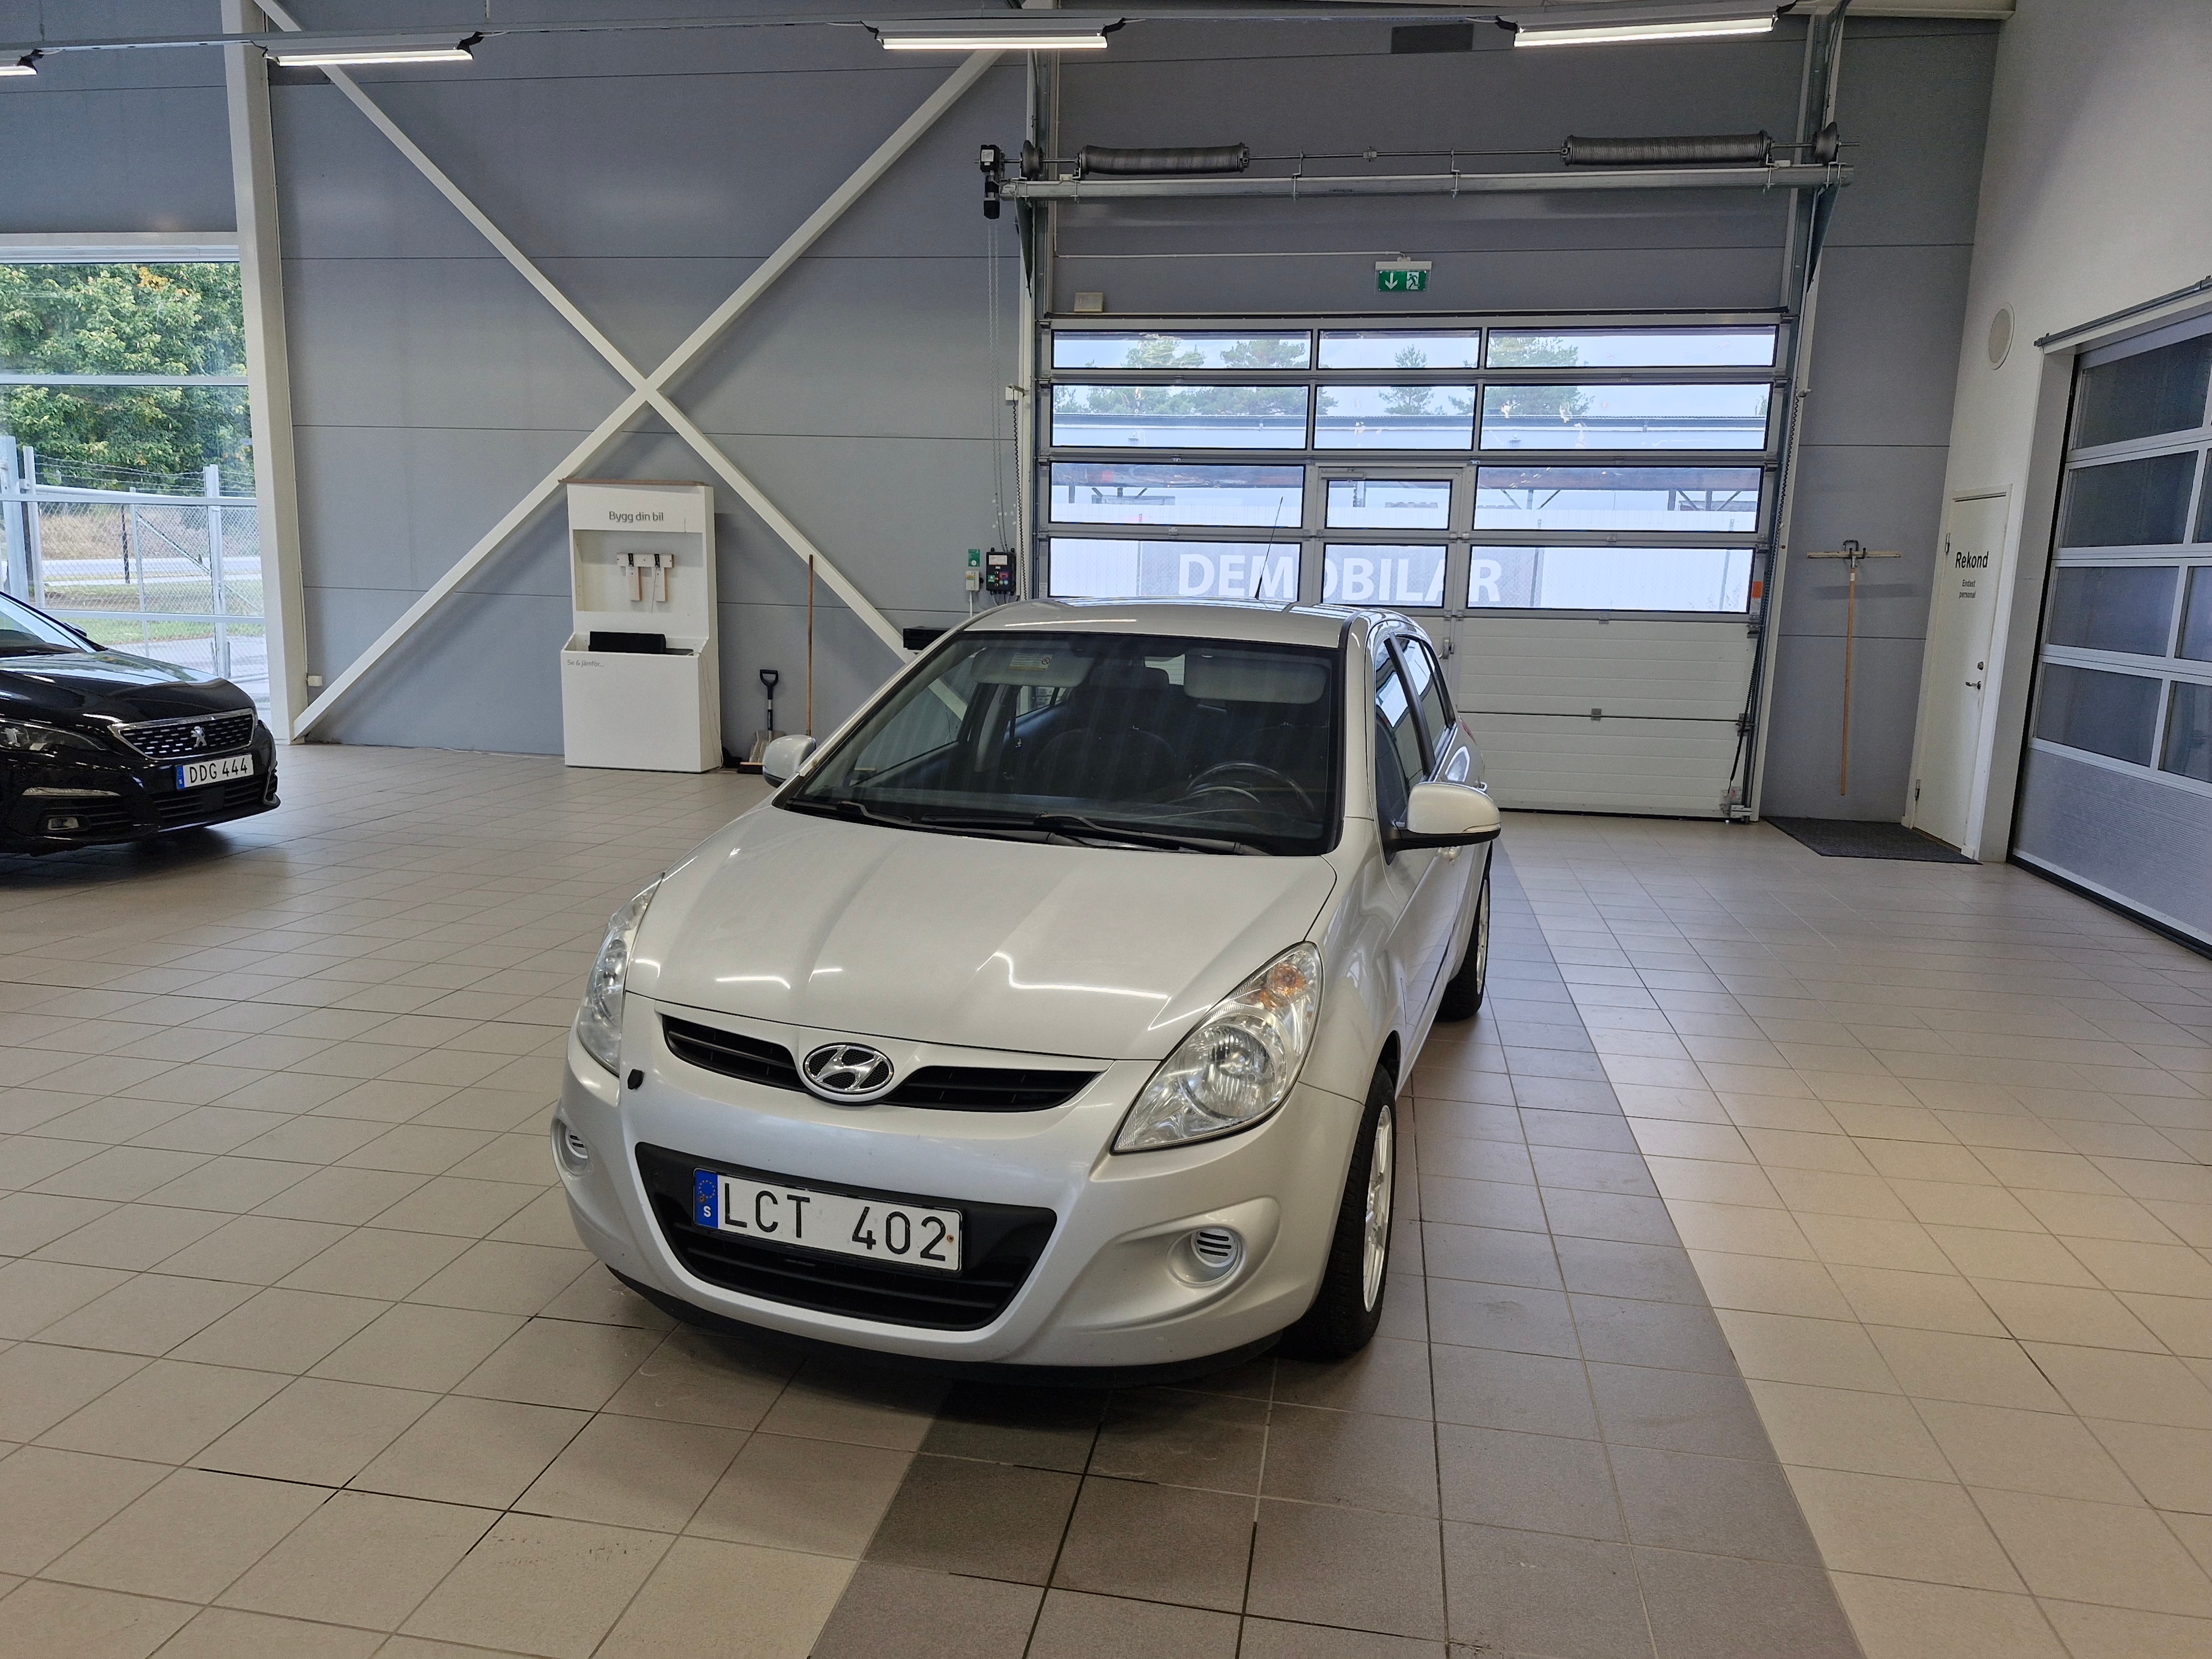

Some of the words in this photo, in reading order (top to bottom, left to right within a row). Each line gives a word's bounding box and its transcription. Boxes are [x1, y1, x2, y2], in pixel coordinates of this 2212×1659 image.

[609, 511, 634, 523] Bygg
[635, 512, 651, 521] din
[653, 512, 664, 521] bil
[1955, 551, 1989, 568] Rekond
[189, 763, 217, 784] DDG
[222, 758, 248, 777] 444
[703, 1206, 712, 1218] S
[724, 1182, 811, 1238] LCT
[852, 1206, 946, 1261] 402
